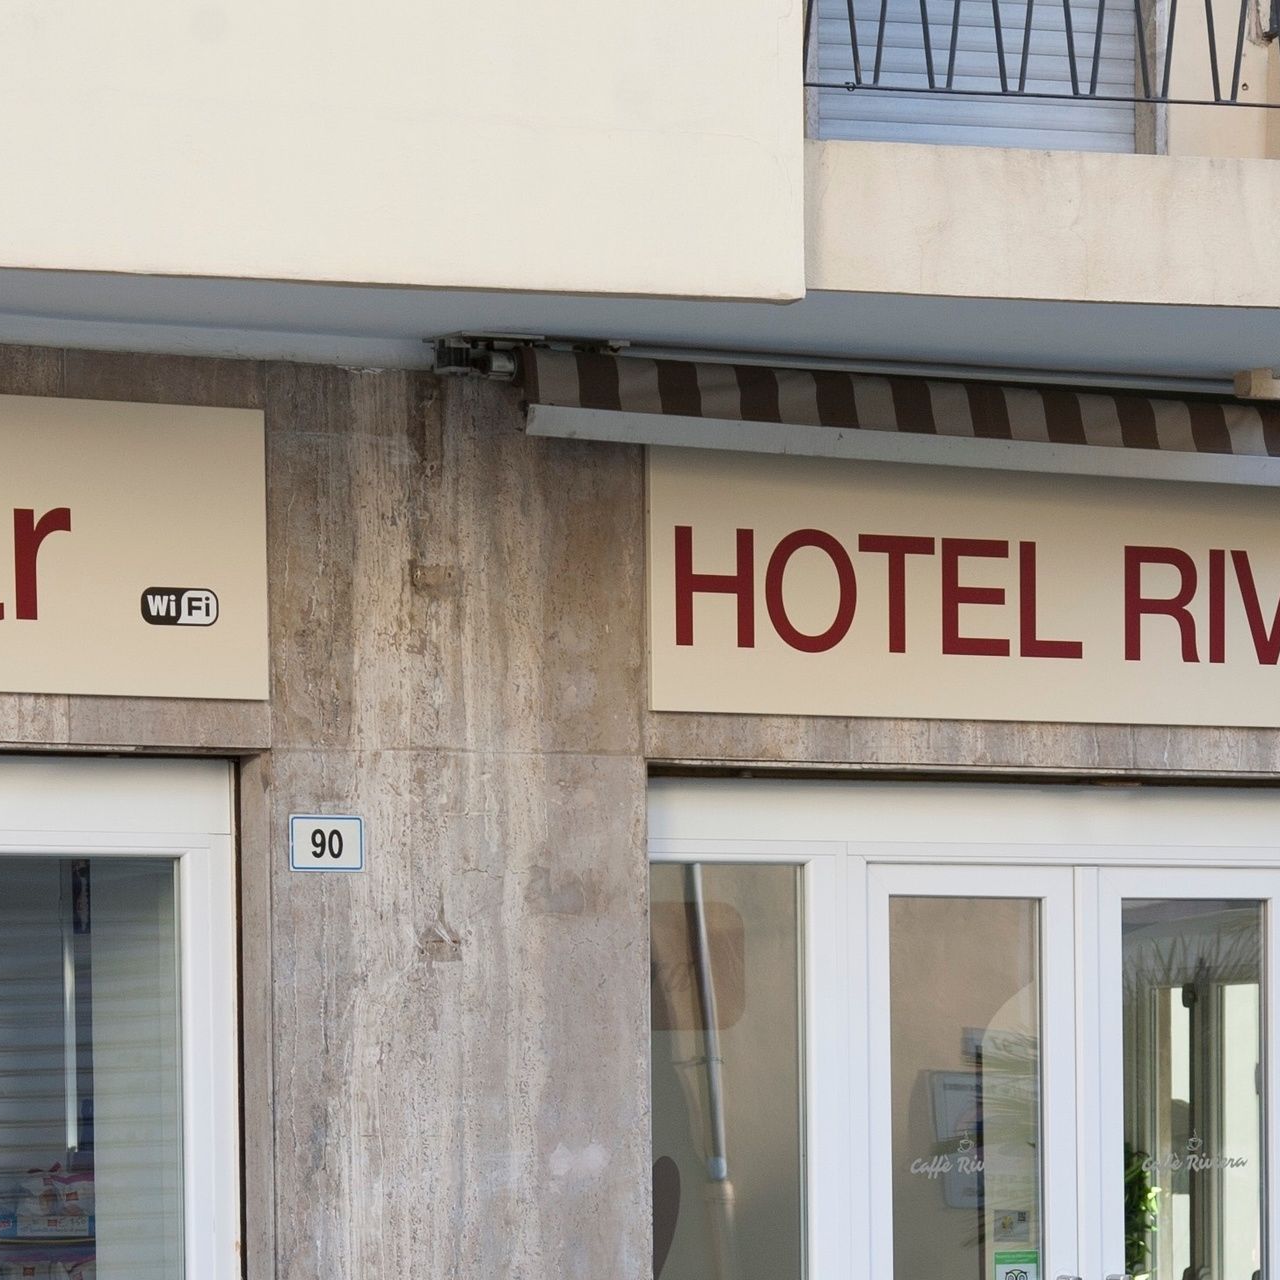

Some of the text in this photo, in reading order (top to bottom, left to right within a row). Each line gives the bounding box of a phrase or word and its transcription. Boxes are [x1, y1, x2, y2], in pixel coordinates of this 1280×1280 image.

[675, 525, 1083, 659] HOTEL
[310, 828, 344, 859] 90
[910, 1154, 953, 1179] Caffè
[1186, 1152, 1248, 1173] Riviera
